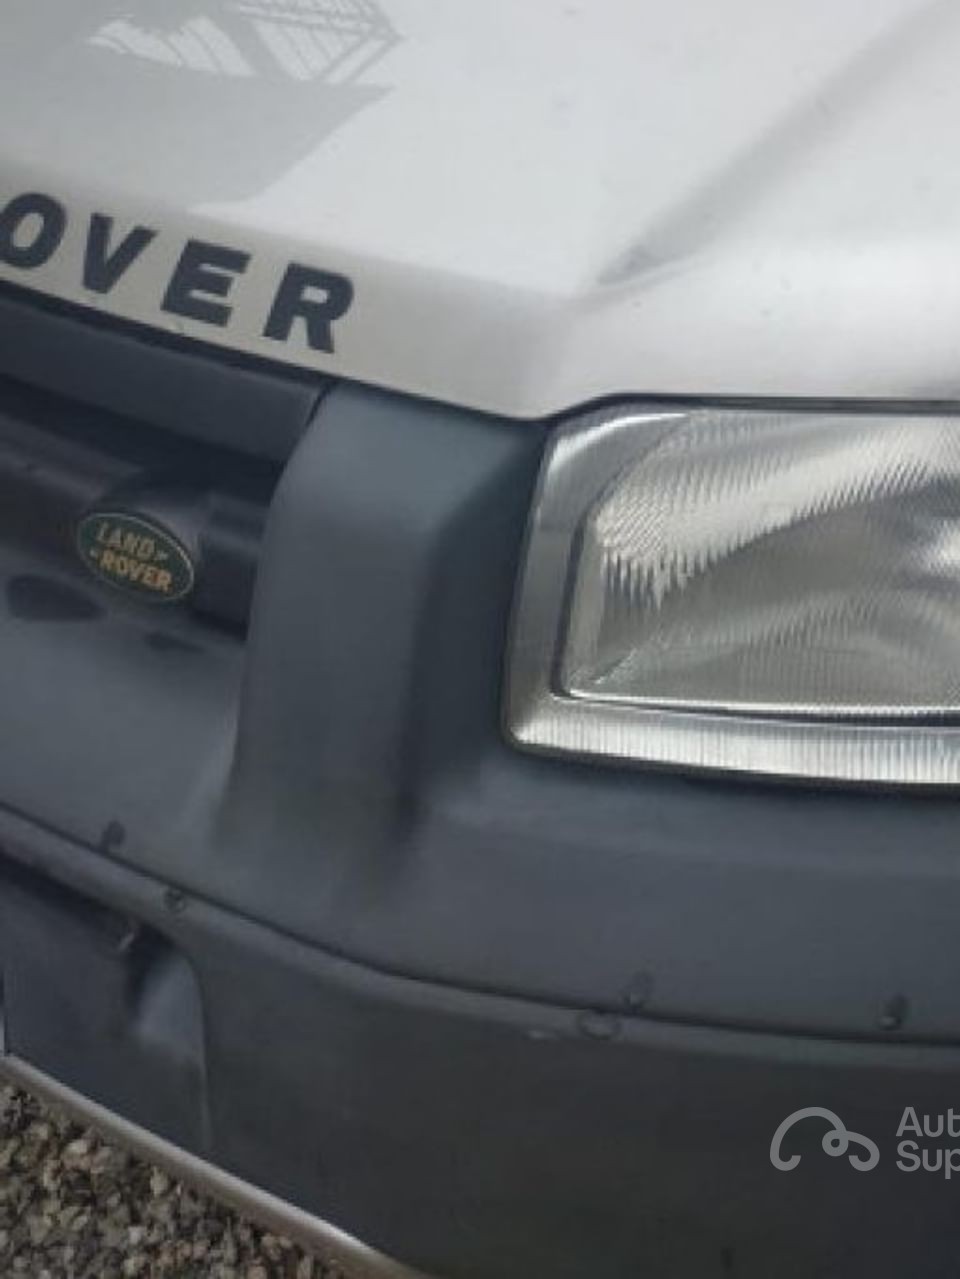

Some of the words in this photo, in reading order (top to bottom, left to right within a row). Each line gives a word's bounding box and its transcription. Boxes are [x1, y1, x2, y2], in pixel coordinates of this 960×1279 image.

[0, 192, 355, 354] OVER
[97, 521, 155, 560] LAND
[100, 549, 172, 593] ROVER
